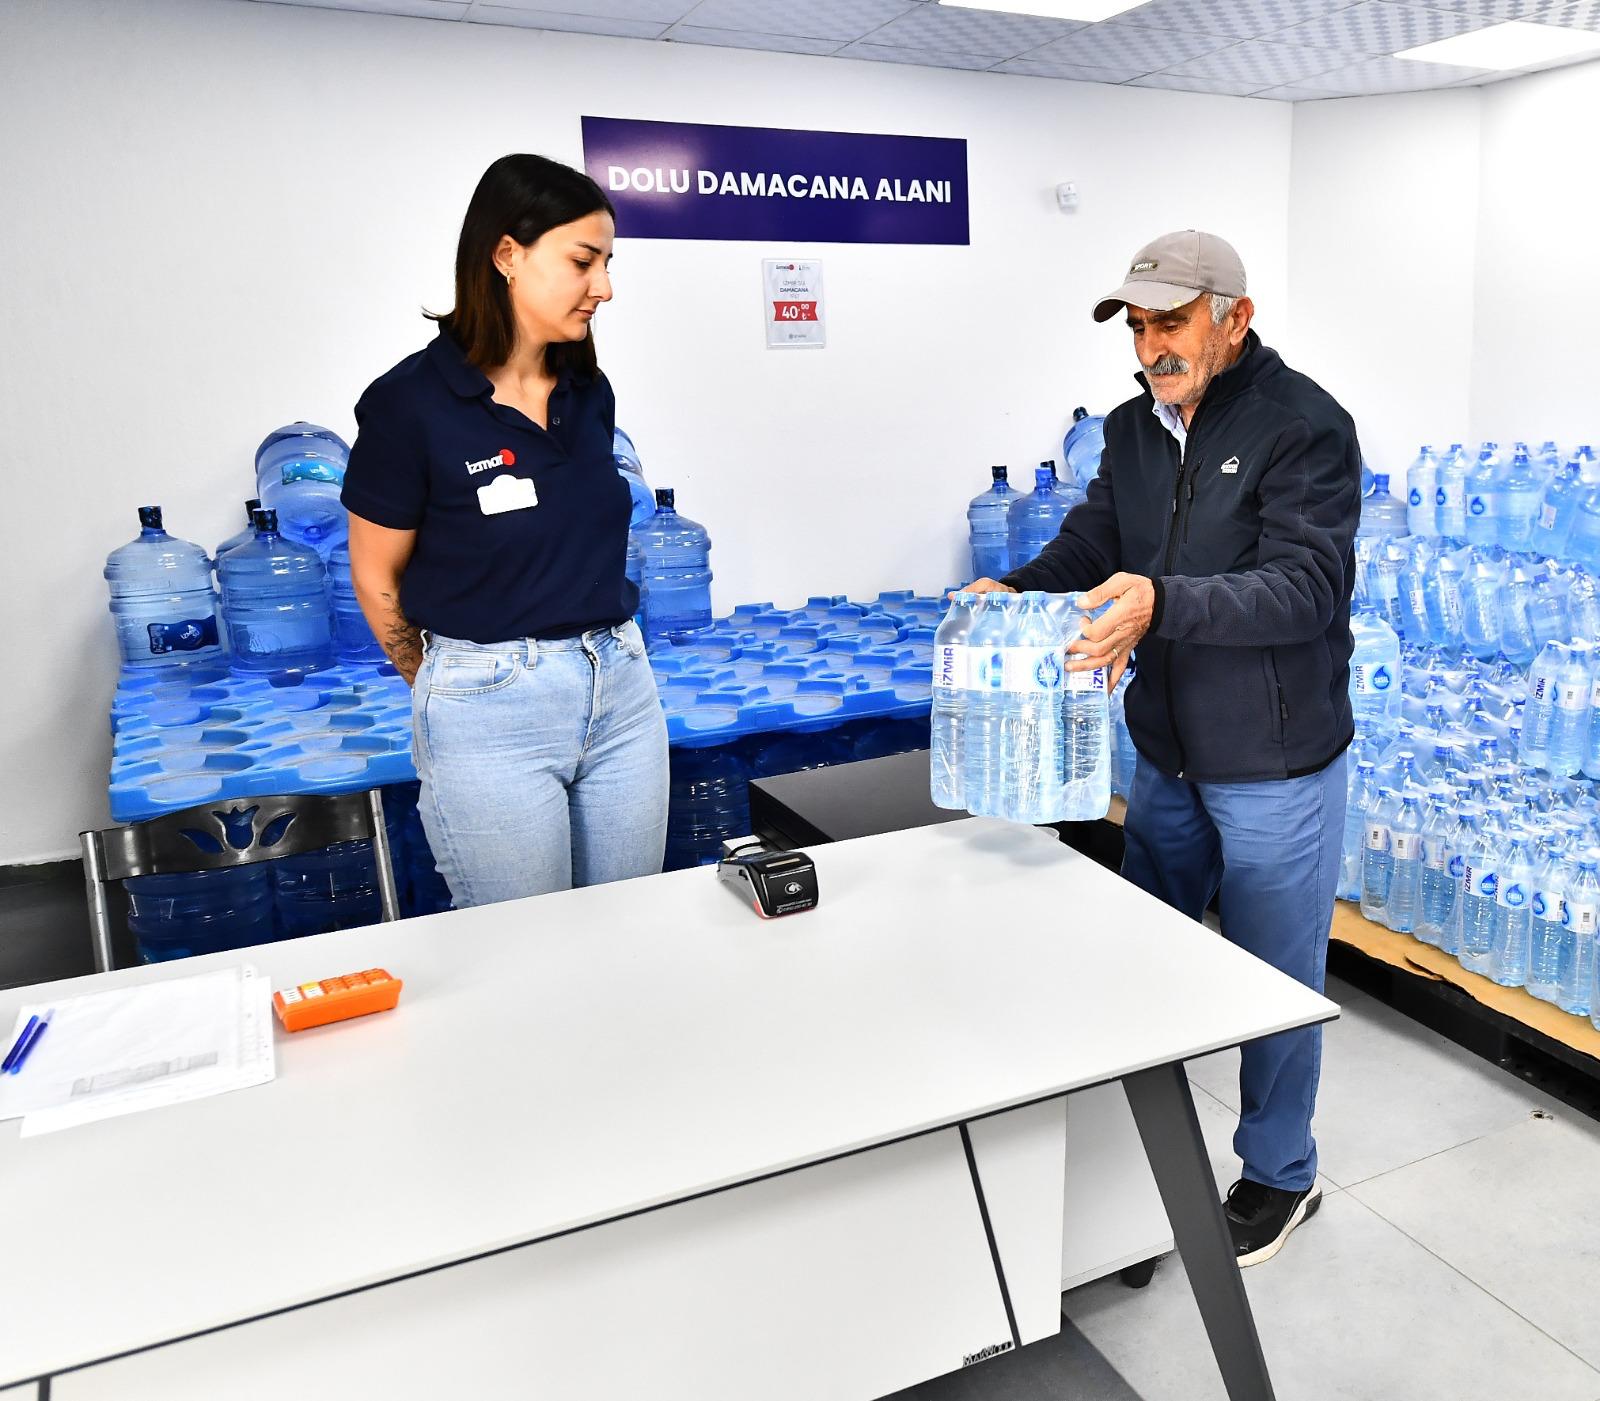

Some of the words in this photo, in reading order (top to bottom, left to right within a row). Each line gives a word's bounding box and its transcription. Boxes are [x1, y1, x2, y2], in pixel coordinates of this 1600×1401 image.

[608, 165, 690, 194] DOLU
[697, 169, 870, 201] DAMACANA
[875, 178, 952, 204] ALANI
[782, 306, 799, 319] 40
